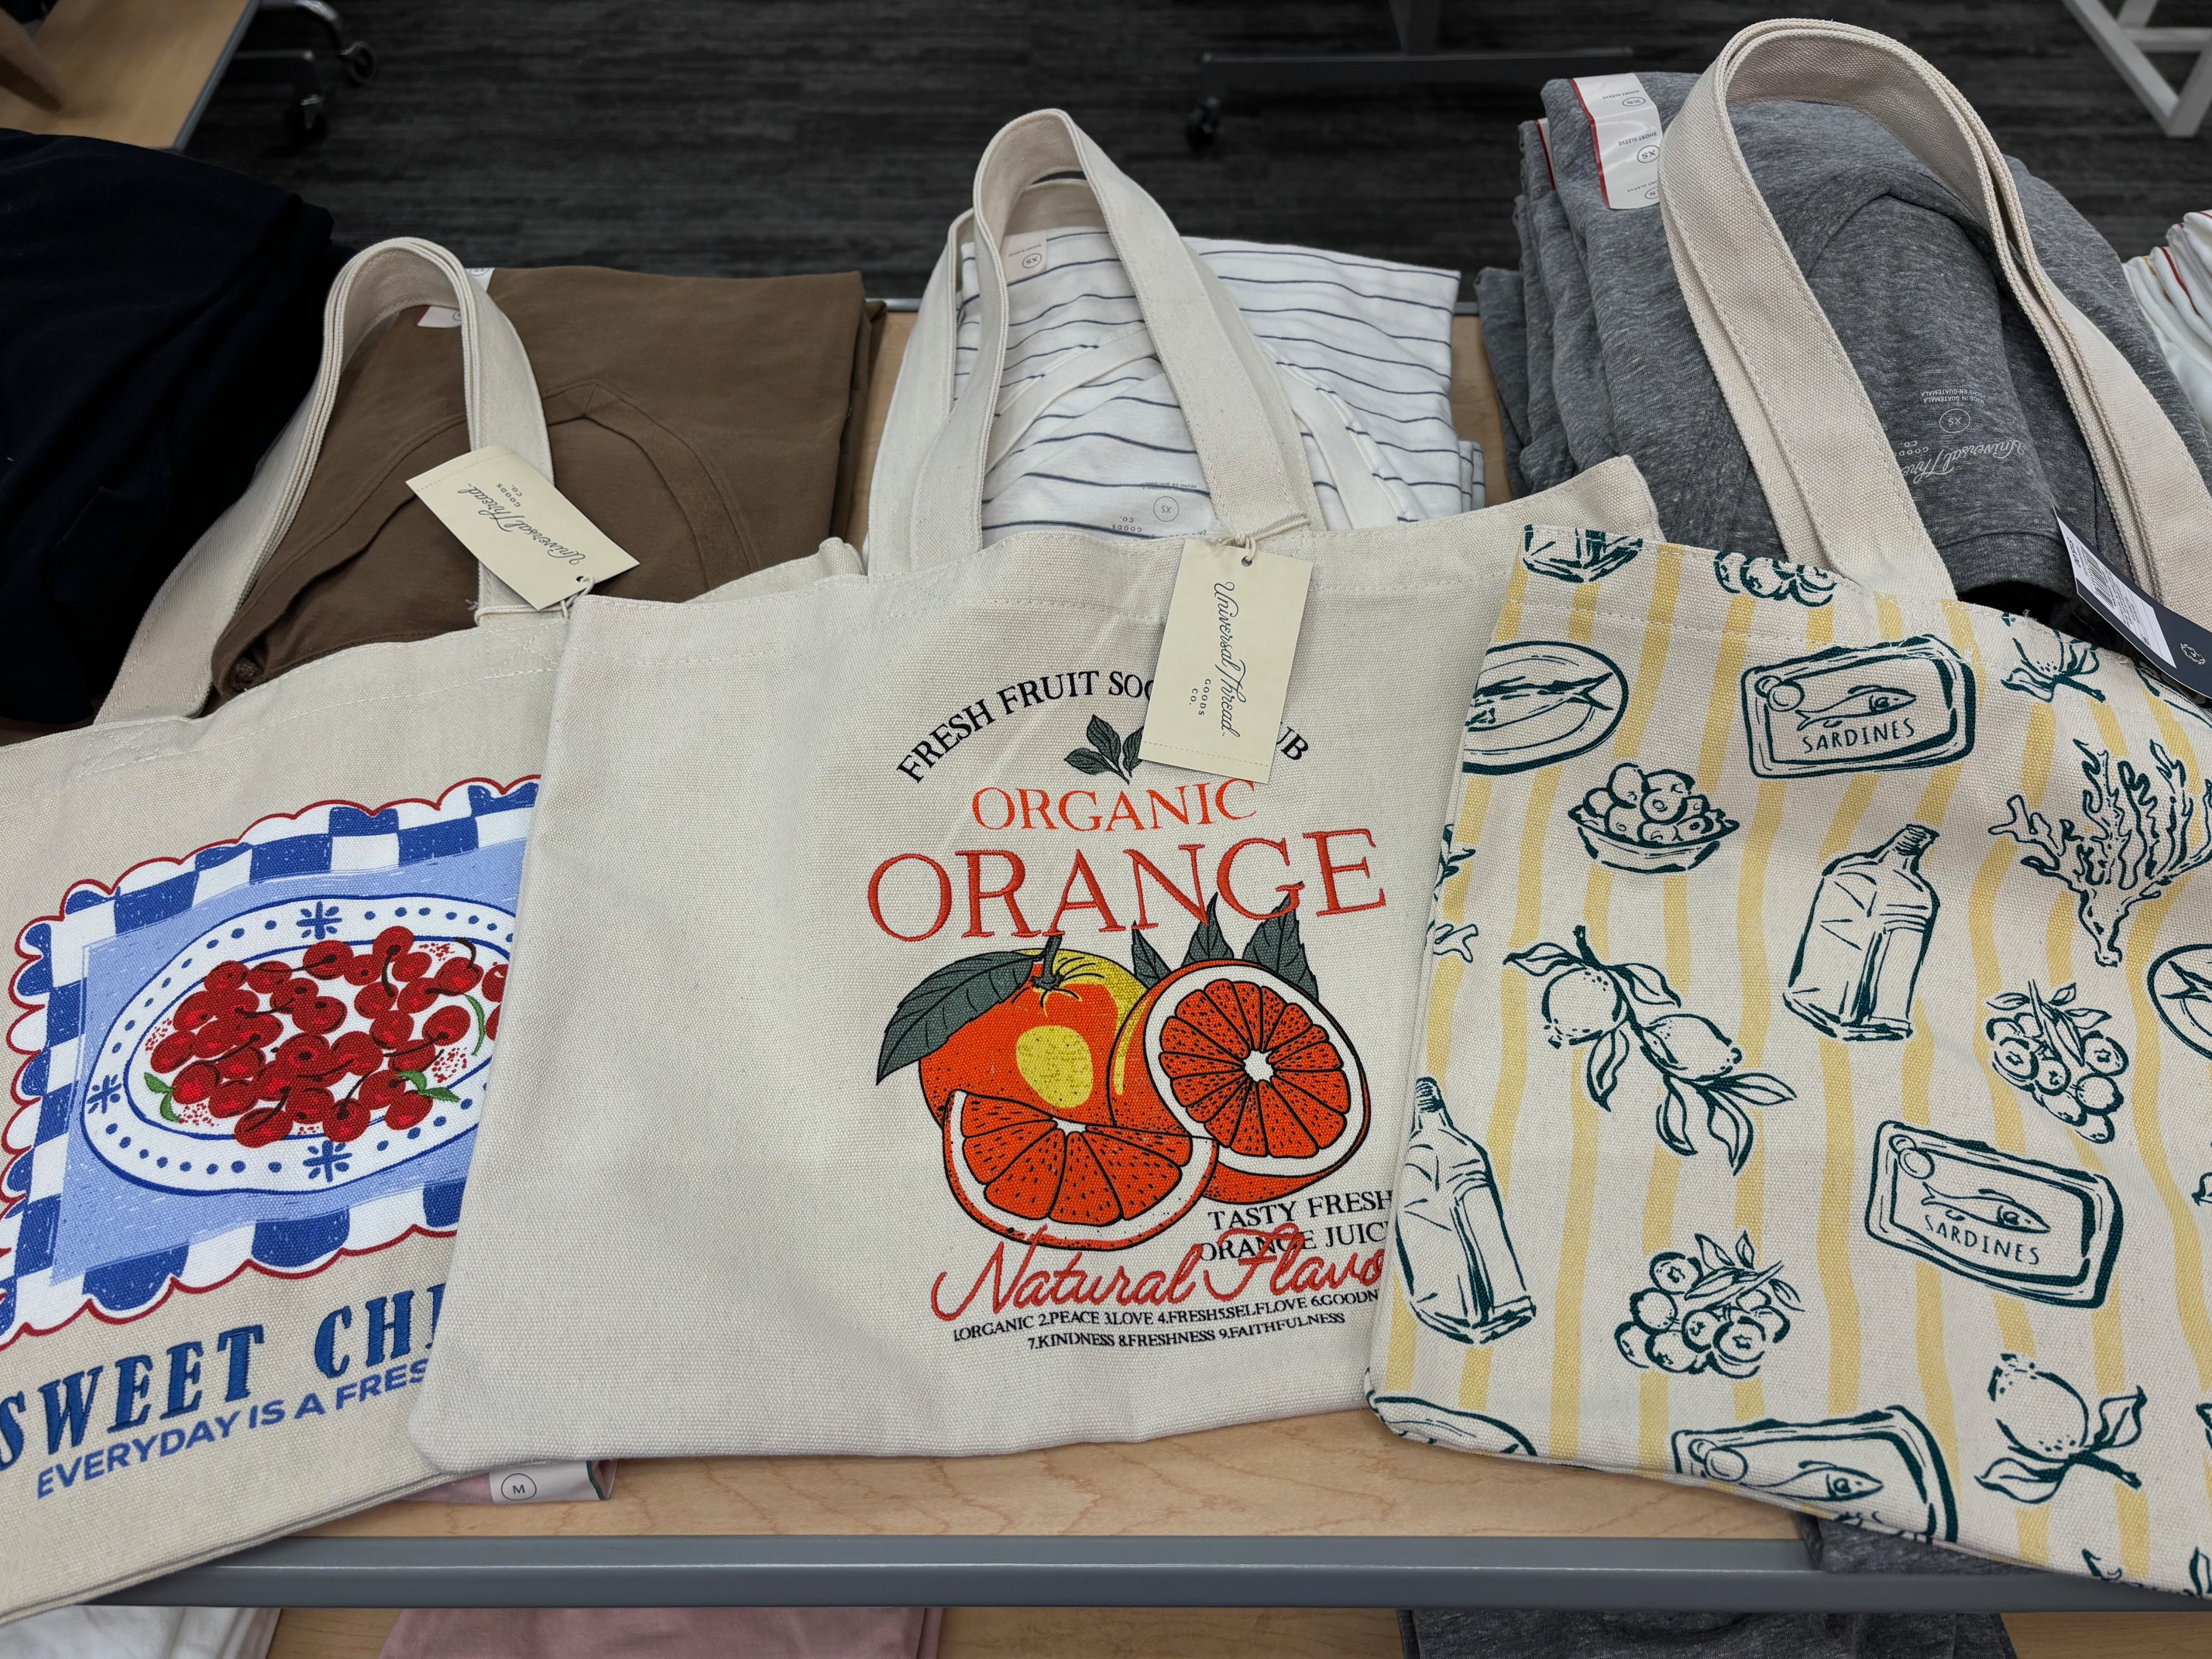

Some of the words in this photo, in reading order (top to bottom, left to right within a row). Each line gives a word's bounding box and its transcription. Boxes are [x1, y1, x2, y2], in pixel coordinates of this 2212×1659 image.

[1618, 137, 1638, 146] SLEEVE
[1639, 132, 1657, 141] SHORT
[1642, 149, 1656, 159] XS
[1948, 417, 1962, 426] XS
[1942, 439, 2025, 472] Universal
[496, 483, 520, 507] GOODS
[512, 484, 523, 496] CO.
[1112, 524, 1142, 533] GOODS
[1161, 505, 1172, 514] XS
[504, 520, 586, 565] Universal
[1214, 582, 1241, 672] Universal
[1189, 688, 1198, 706] CO.
[1198, 678, 1211, 716] GOODS
[896, 699, 996, 784] FRESH
[997, 670, 1099, 715] FRUIT
[1802, 718, 1915, 754] SARDINES
[972, 778, 1258, 832] ORGANIC
[867, 828, 1386, 942] ORANGE
[1207, 1200, 1297, 1230] TASTY
[1307, 1189, 1393, 1218] FRESH
[1200, 1230, 1317, 1262] ORANGE
[1326, 1220, 1389, 1248] JUIC
[1925, 1214, 2040, 1266] SARDINES
[931, 1224, 1203, 1321] Natural
[1039, 1310, 1100, 1326] 2.PEACE
[1104, 1311, 1154, 1325] 3.LOVE
[1310, 1288, 1380, 1307] 6.GOODN
[1027, 1332, 1115, 1351] 7.KINDNESS
[1219, 1312, 1346, 1339] 9.FAITHFULNESS
[0, 1324, 264, 1472] SWEET
[37, 1410, 241, 1500] EVERYDAY
[248, 1398, 286, 1429] IS
[295, 1392, 326, 1420] A
[336, 1358, 429, 1410] FRES
[513, 1483, 526, 1495] M
